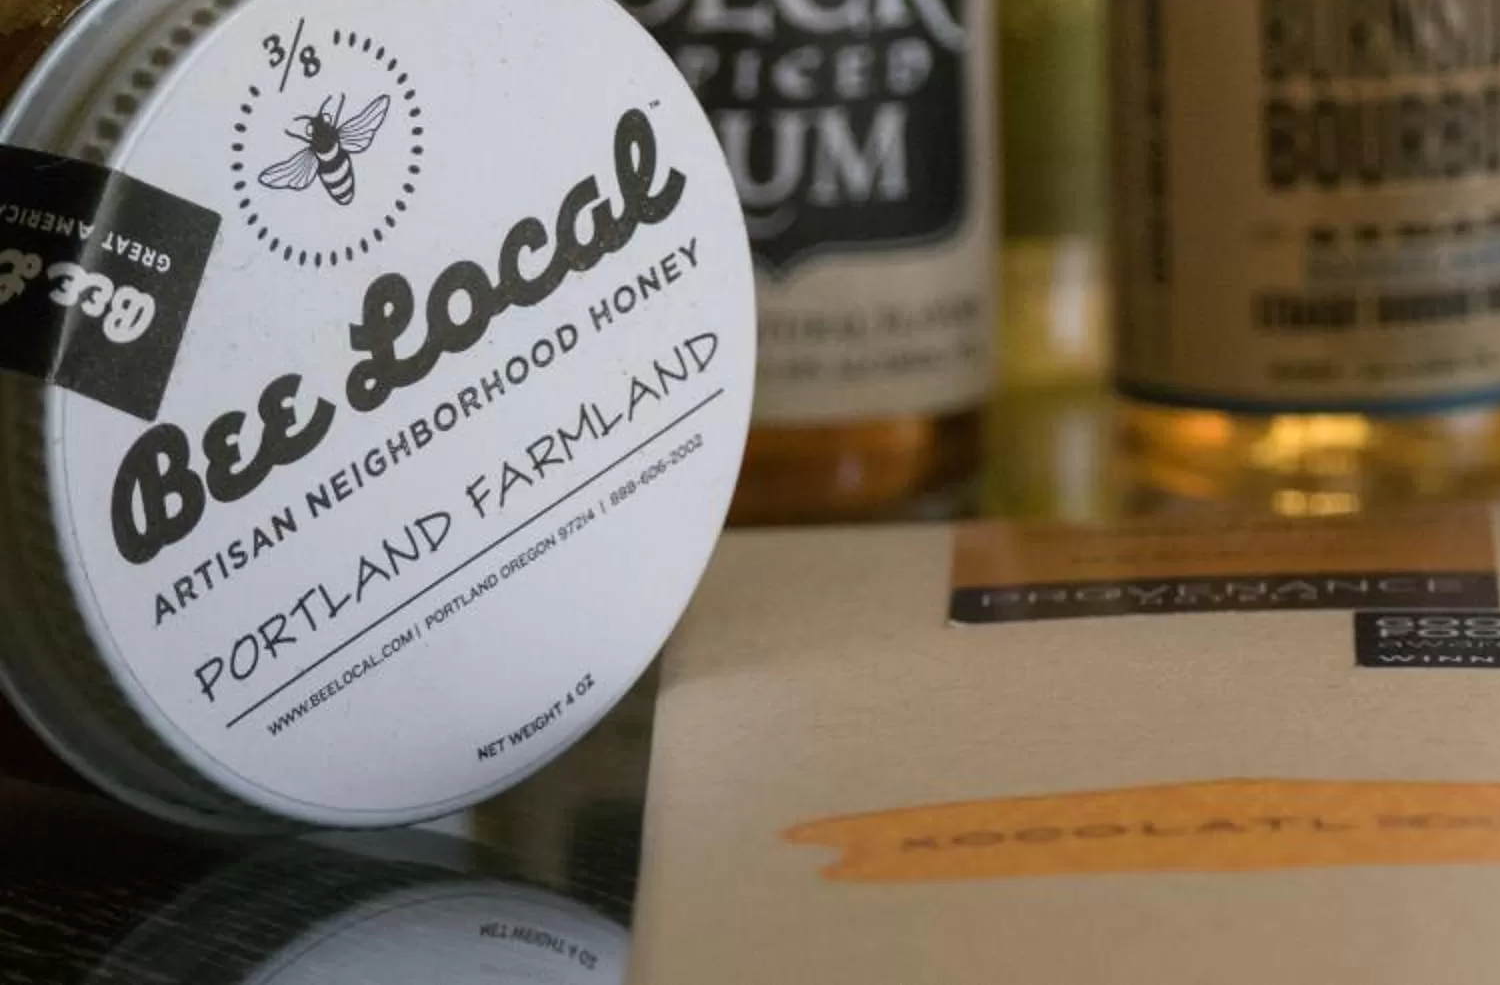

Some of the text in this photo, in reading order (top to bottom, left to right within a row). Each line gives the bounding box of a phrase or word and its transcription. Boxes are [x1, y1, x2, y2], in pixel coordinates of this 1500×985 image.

[672, 37, 933, 101] PICED
[714, 100, 912, 207] UM
[0, 204, 171, 272] GREAT AMERIC
[154, 237, 702, 626] ARTISAN NEIGHBORHOOD HONEY
[194, 332, 719, 702] PORTLAND FARMLAND
[267, 629, 413, 736] WWW.BEELOCAL.COM
[425, 573, 499, 630] PORTLAND
[500, 534, 557, 579] OREGON
[557, 508, 596, 542] 97214
[477, 672, 595, 761] NET WEIGHT 4 OZ
